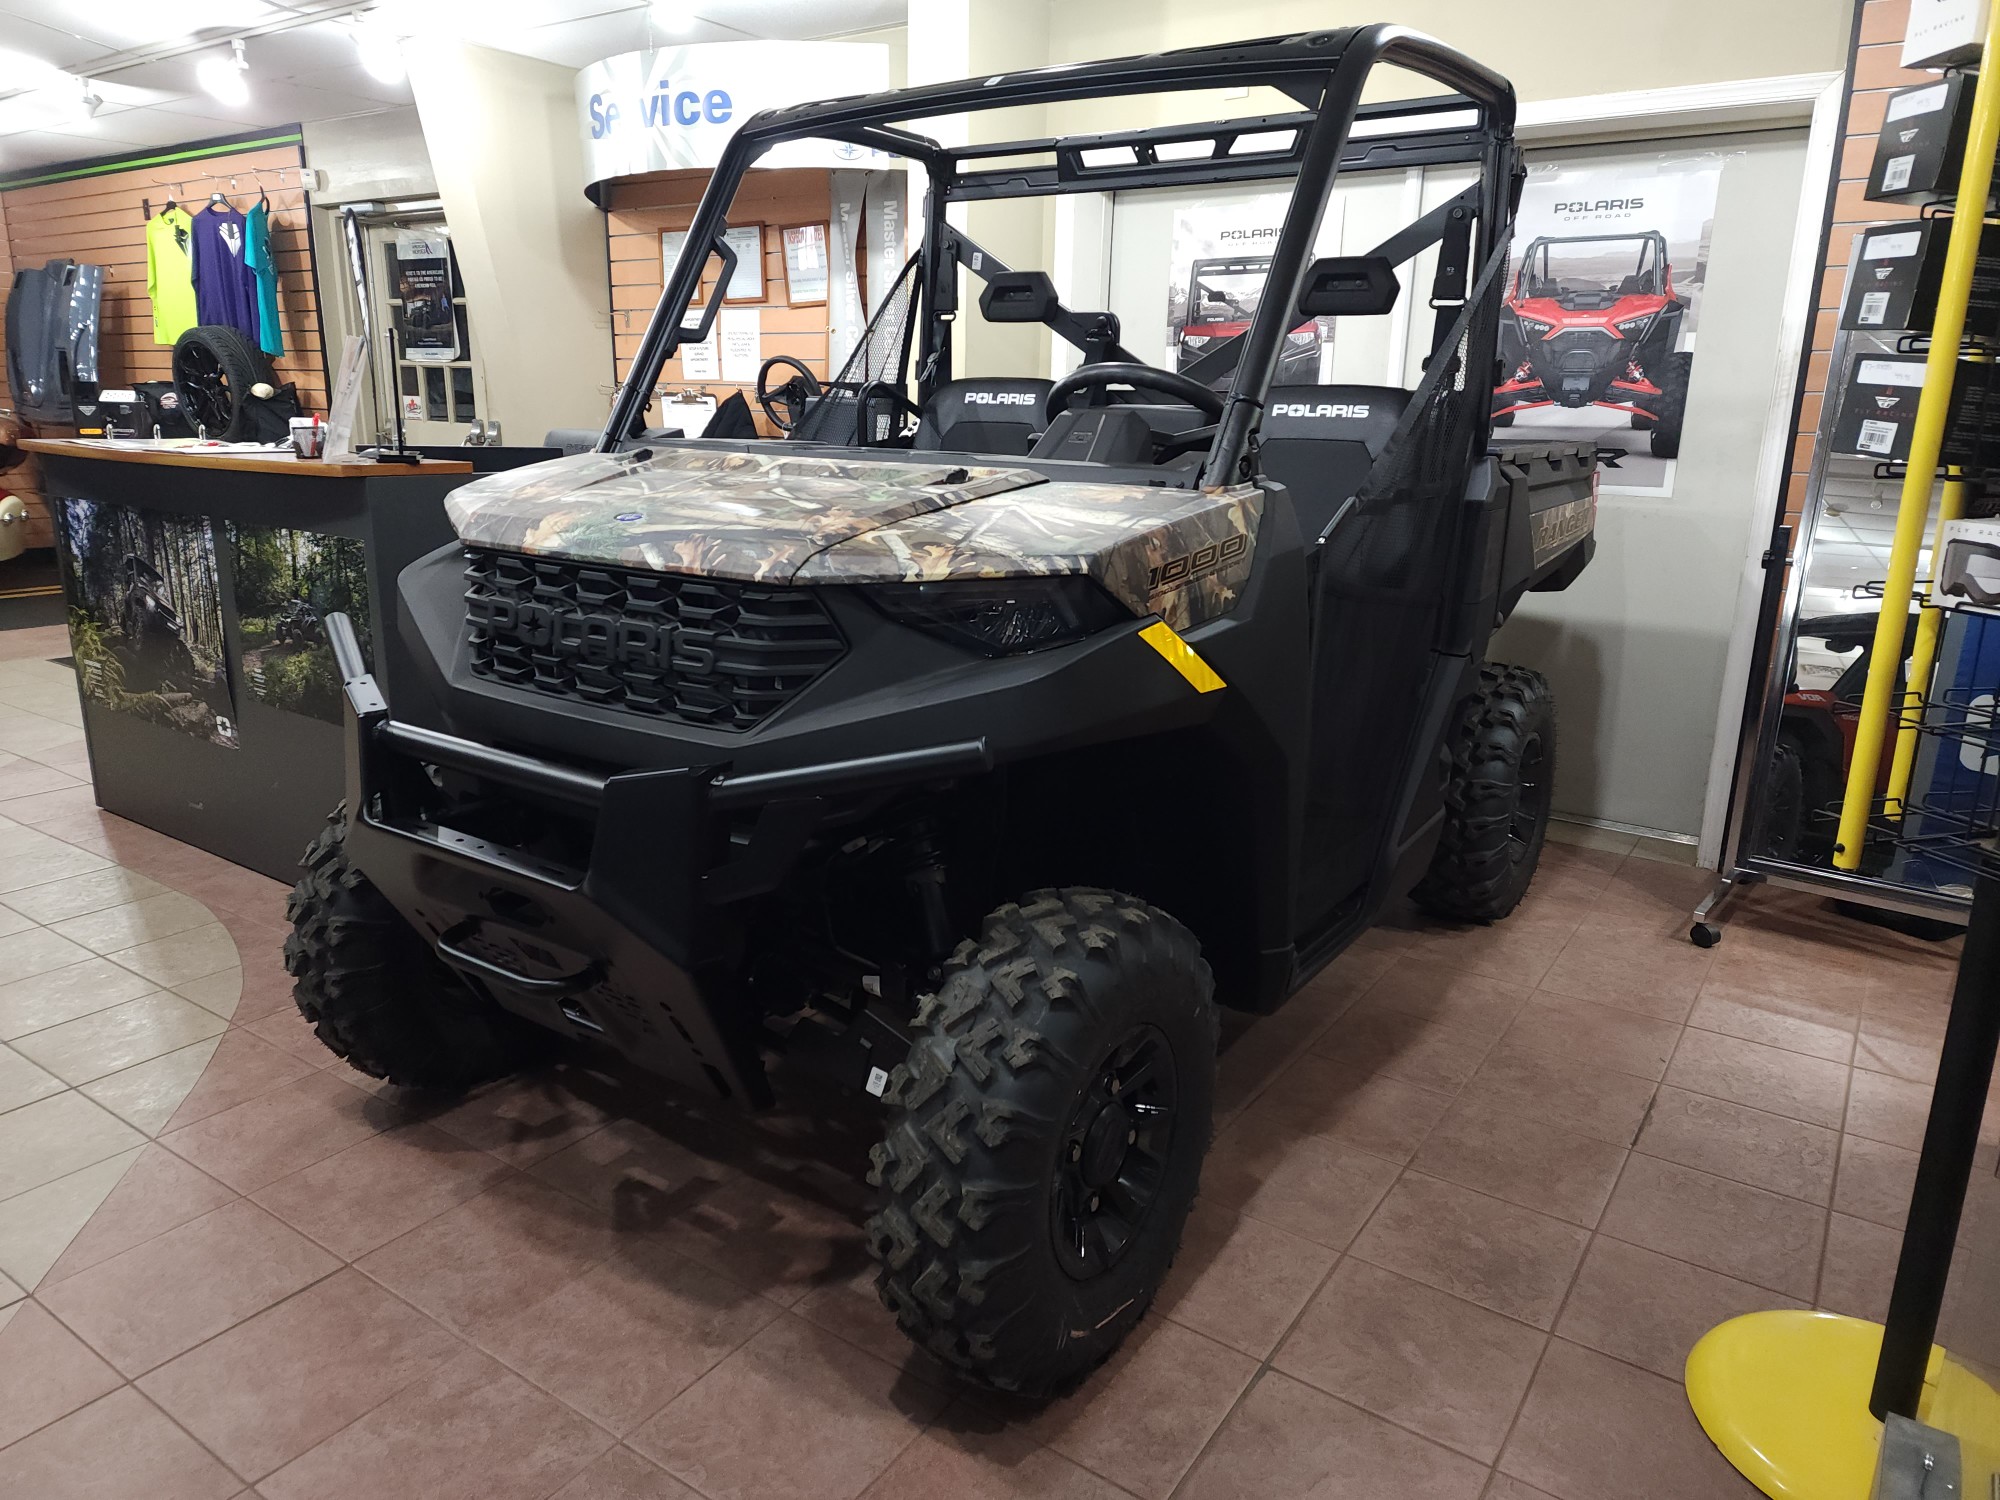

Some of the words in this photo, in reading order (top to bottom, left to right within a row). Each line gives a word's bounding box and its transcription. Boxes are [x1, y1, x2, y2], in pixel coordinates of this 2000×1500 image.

[589, 79, 733, 139] Sevice
[883, 200, 898, 265] Master
[1554, 198, 1644, 214] POLARIS
[1595, 212, 1631, 220] ROAD
[839, 203, 851, 265] Master
[844, 271, 857, 322] Silver
[964, 392, 1036, 405] POLARIS
[1271, 404, 1370, 418] POLARIS
[1147, 532, 1249, 591] 1000
[486, 594, 717, 677] POLARIS
